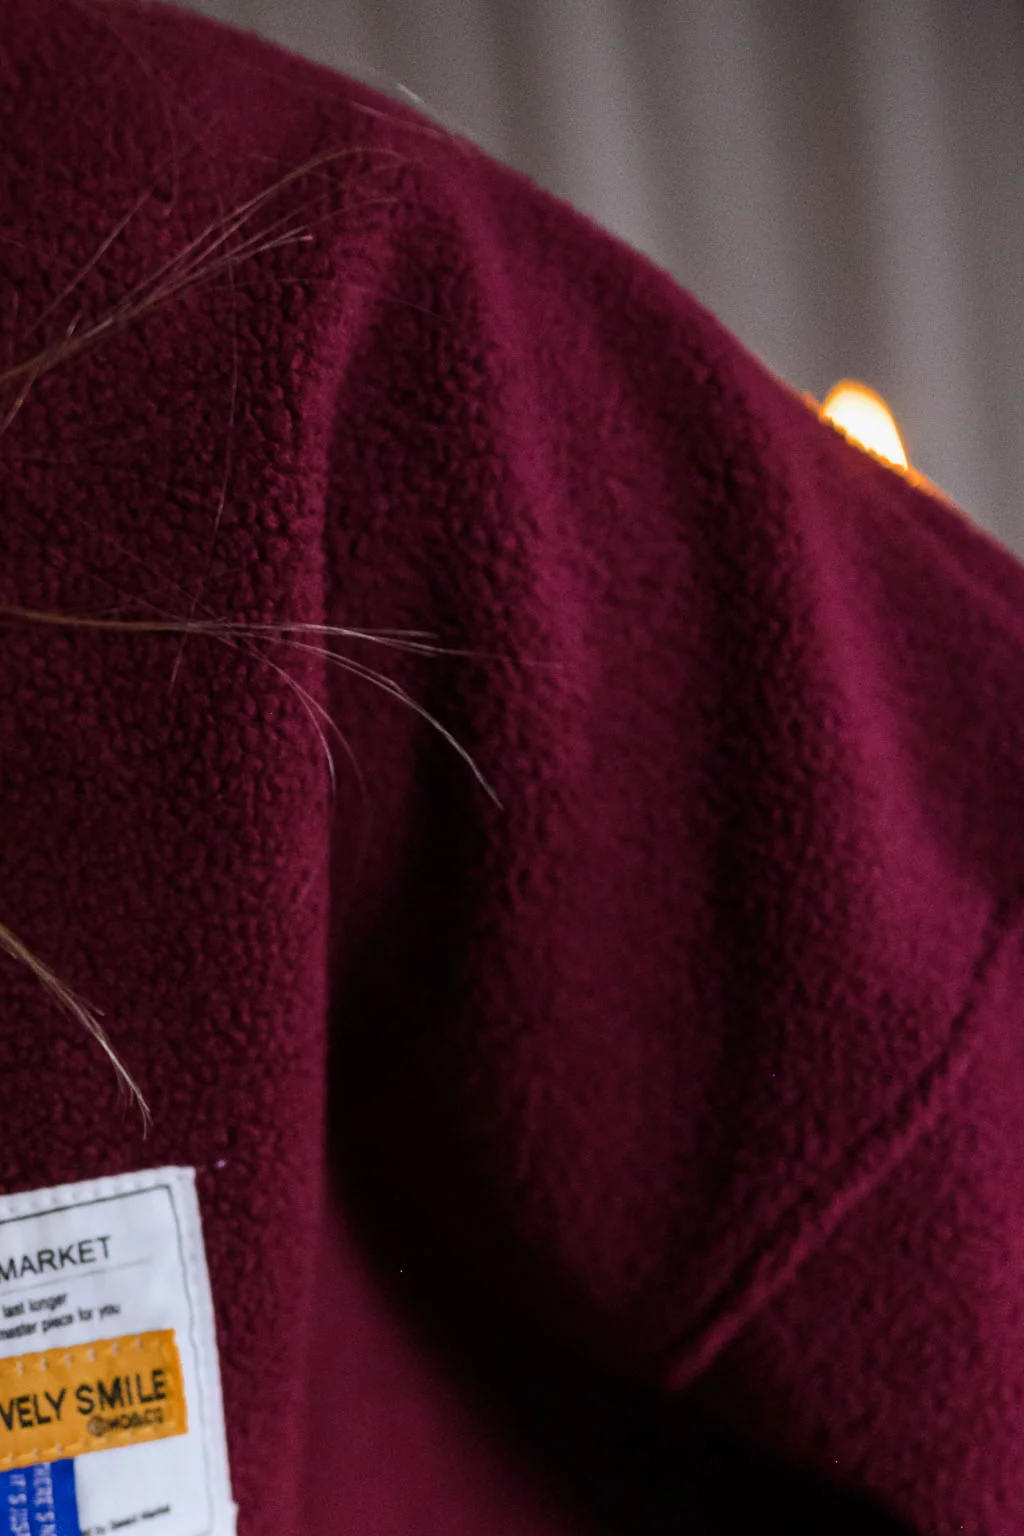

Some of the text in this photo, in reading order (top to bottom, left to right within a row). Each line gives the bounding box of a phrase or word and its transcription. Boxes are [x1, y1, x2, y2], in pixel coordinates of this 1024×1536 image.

[29, 1293, 68, 1315] longer
[99, 1303, 121, 1319] you
[77, 1369, 167, 1415] SMILE
